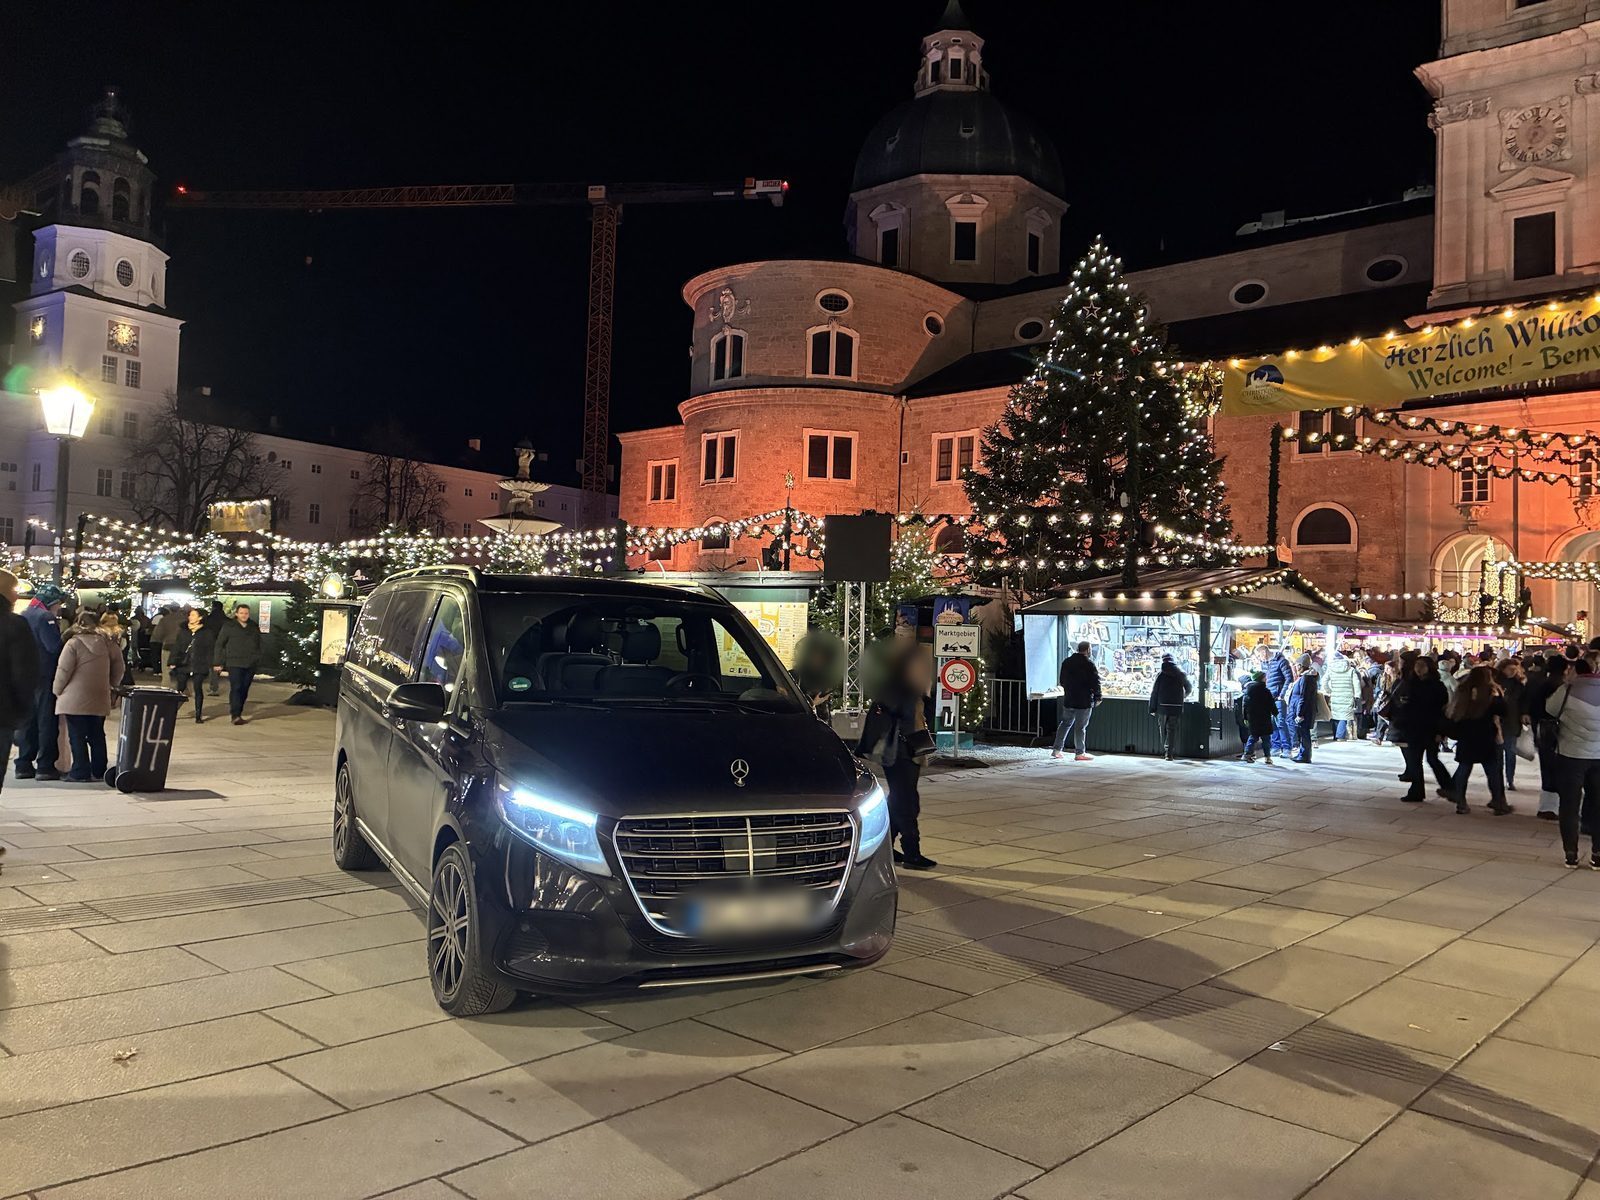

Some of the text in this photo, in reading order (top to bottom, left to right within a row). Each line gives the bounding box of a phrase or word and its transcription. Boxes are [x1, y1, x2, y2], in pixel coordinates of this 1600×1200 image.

[1384, 310, 1600, 370] Herzlich Willko
[1407, 353, 1514, 391] Welcome!
[938, 630, 976, 638] Marktgebiet
[134, 704, 169, 771] 14
